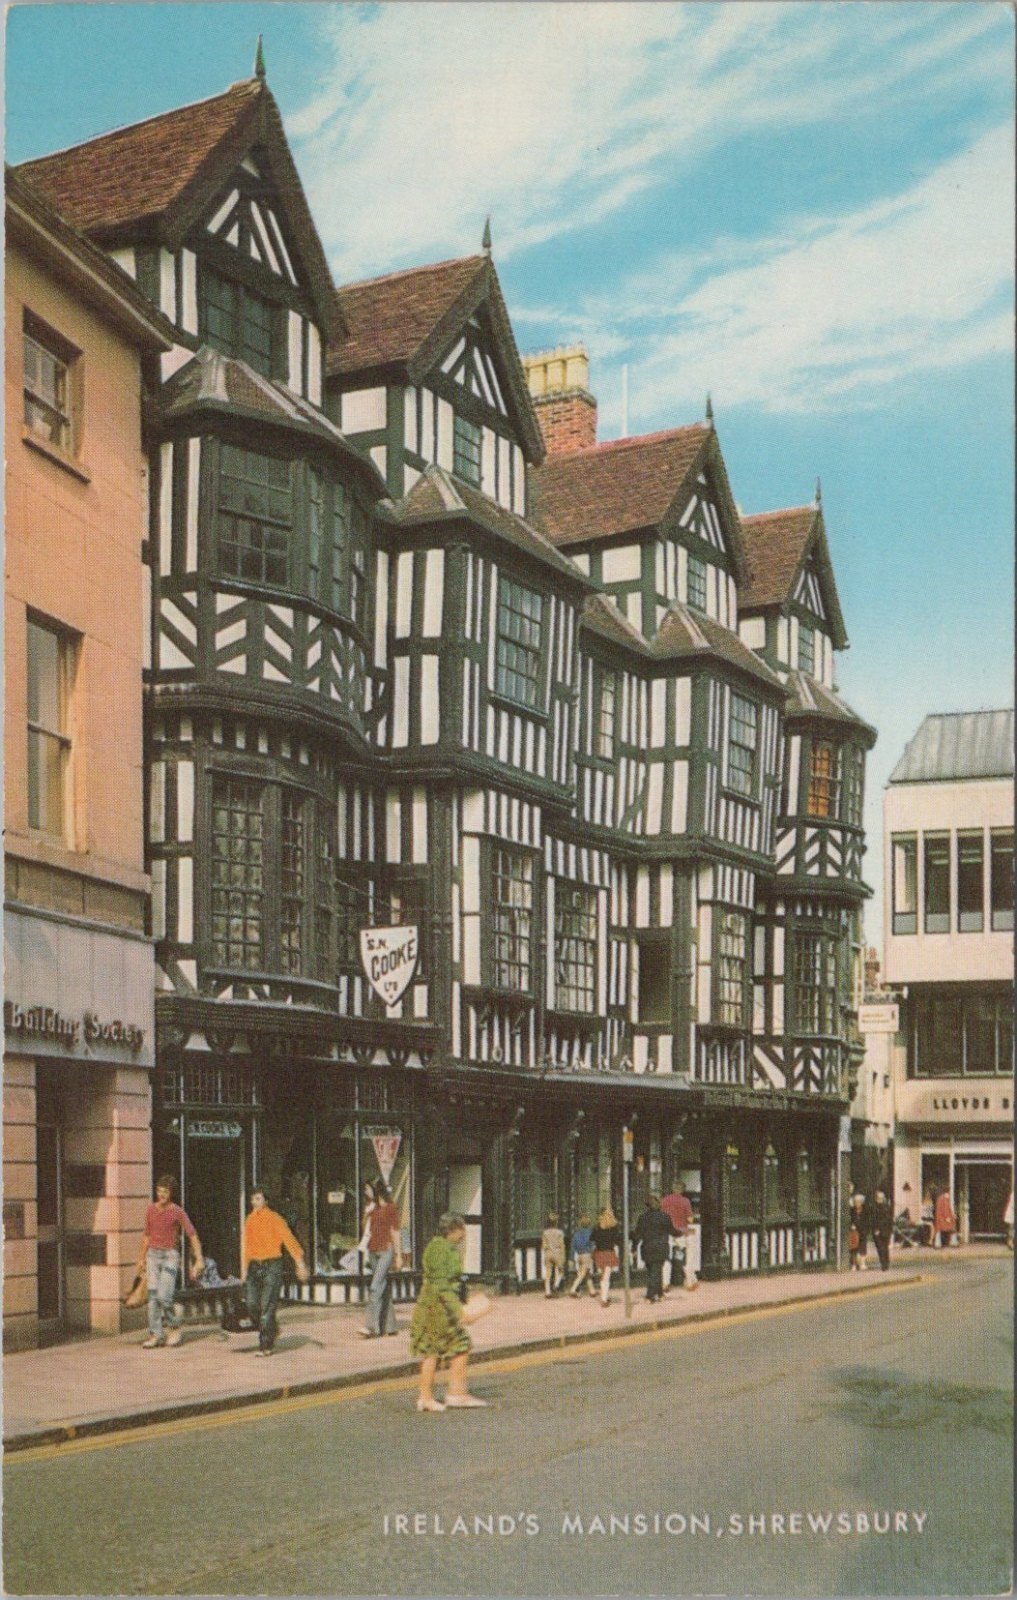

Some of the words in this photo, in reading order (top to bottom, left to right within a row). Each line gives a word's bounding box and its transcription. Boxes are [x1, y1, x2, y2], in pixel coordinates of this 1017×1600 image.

[371, 938, 416, 982] COOKE
[4, 1002, 80, 1051] Building
[84, 1011, 146, 1055] Society
[933, 1097, 990, 1110] LLOYDS
